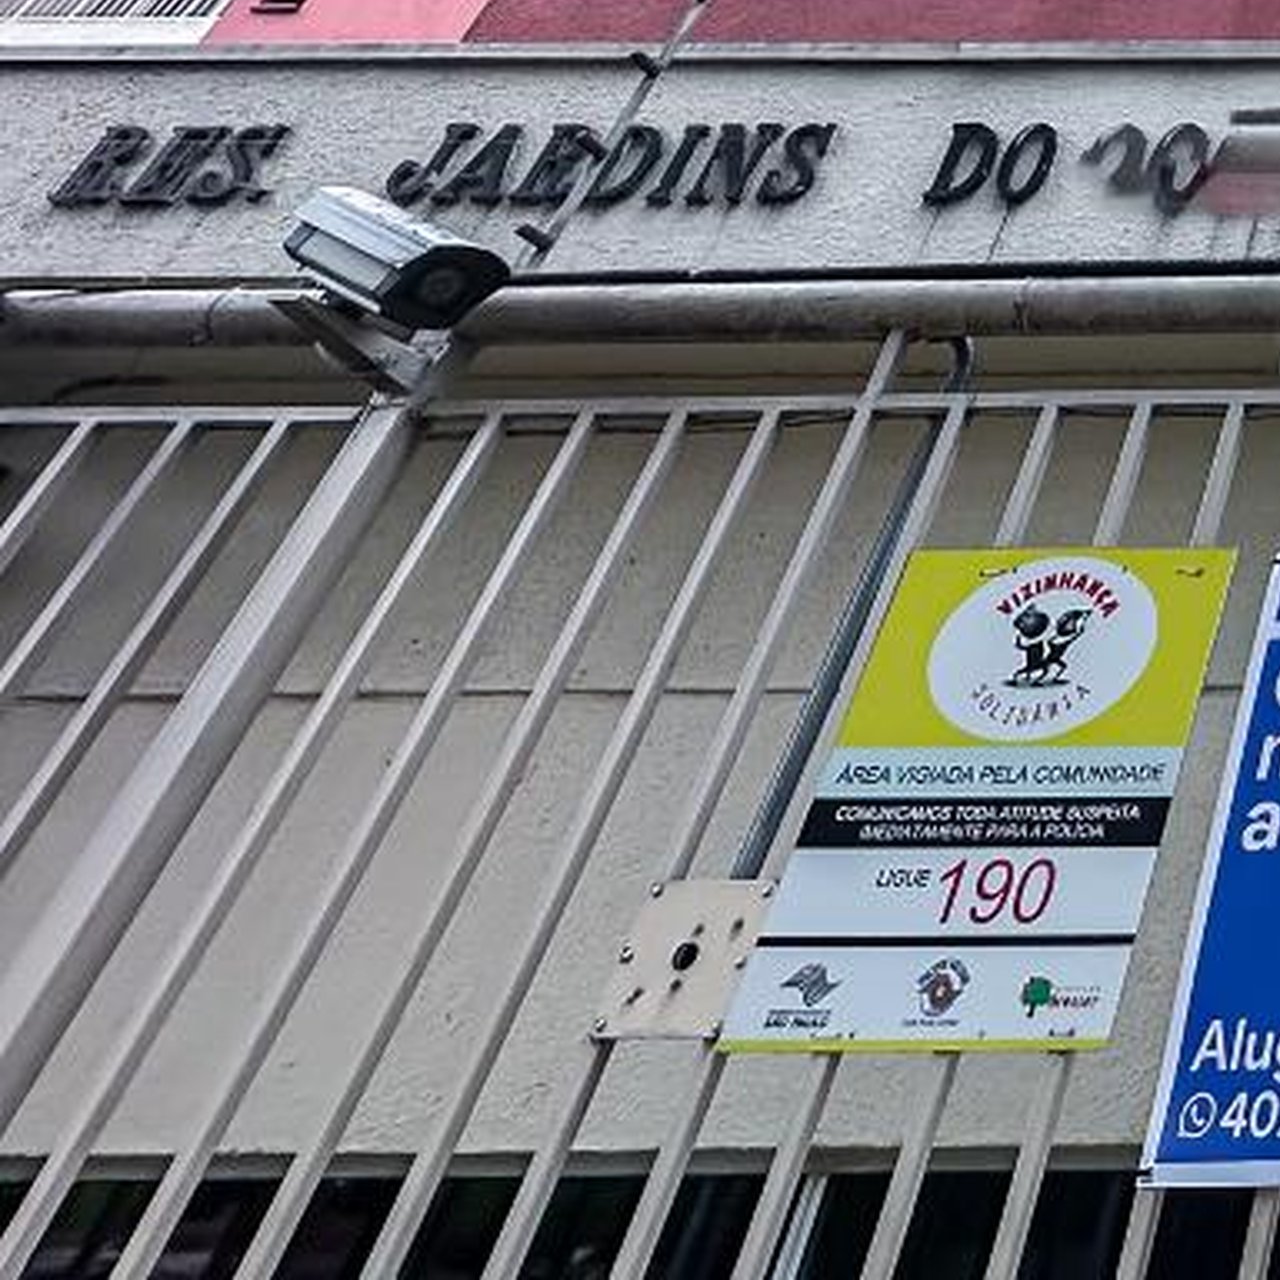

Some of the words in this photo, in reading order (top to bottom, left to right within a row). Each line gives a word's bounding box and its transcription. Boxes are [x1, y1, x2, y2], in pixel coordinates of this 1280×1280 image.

[385, 122, 838, 210] JARDINS
[921, 122, 1058, 208] DO
[835, 763, 891, 785] ÁREA
[978, 764, 1026, 784] PELA
[1031, 762, 1166, 784] COMUNIDADE
[875, 869, 932, 888] LIGUE
[939, 858, 1057, 925] 190
